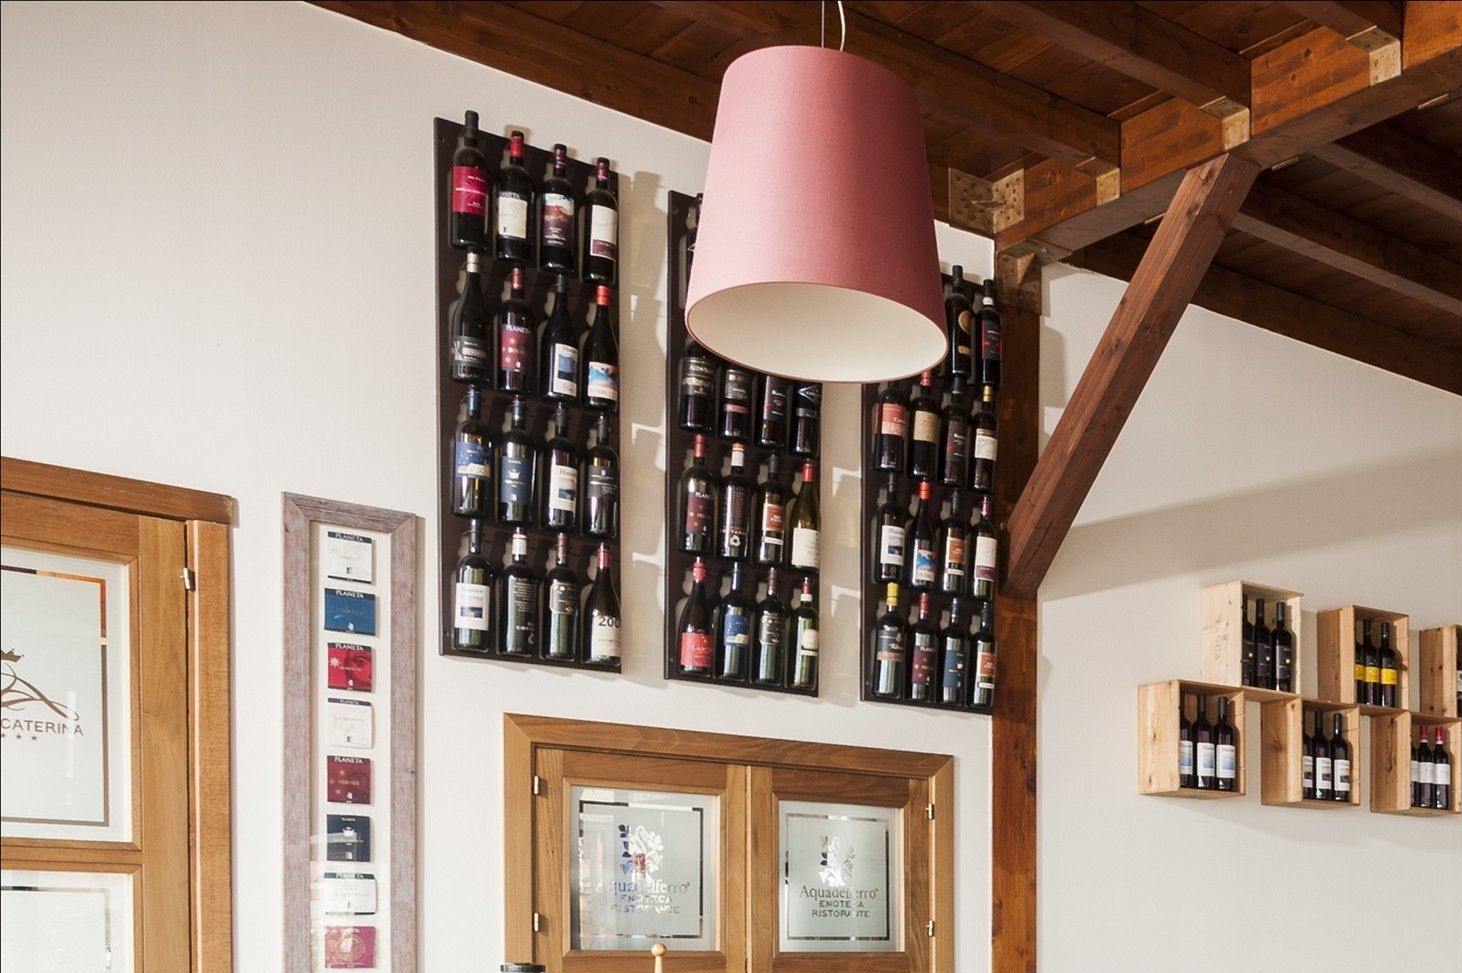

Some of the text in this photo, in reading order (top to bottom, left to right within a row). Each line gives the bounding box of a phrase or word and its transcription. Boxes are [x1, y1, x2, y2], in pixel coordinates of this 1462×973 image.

[335, 589, 365, 599] PLANETA
[335, 642, 364, 652] PLANETA
[334, 756, 363, 764] PLANETA
[799, 885, 879, 901] Aquadelrro
[819, 900, 865, 909] ENOTEA
